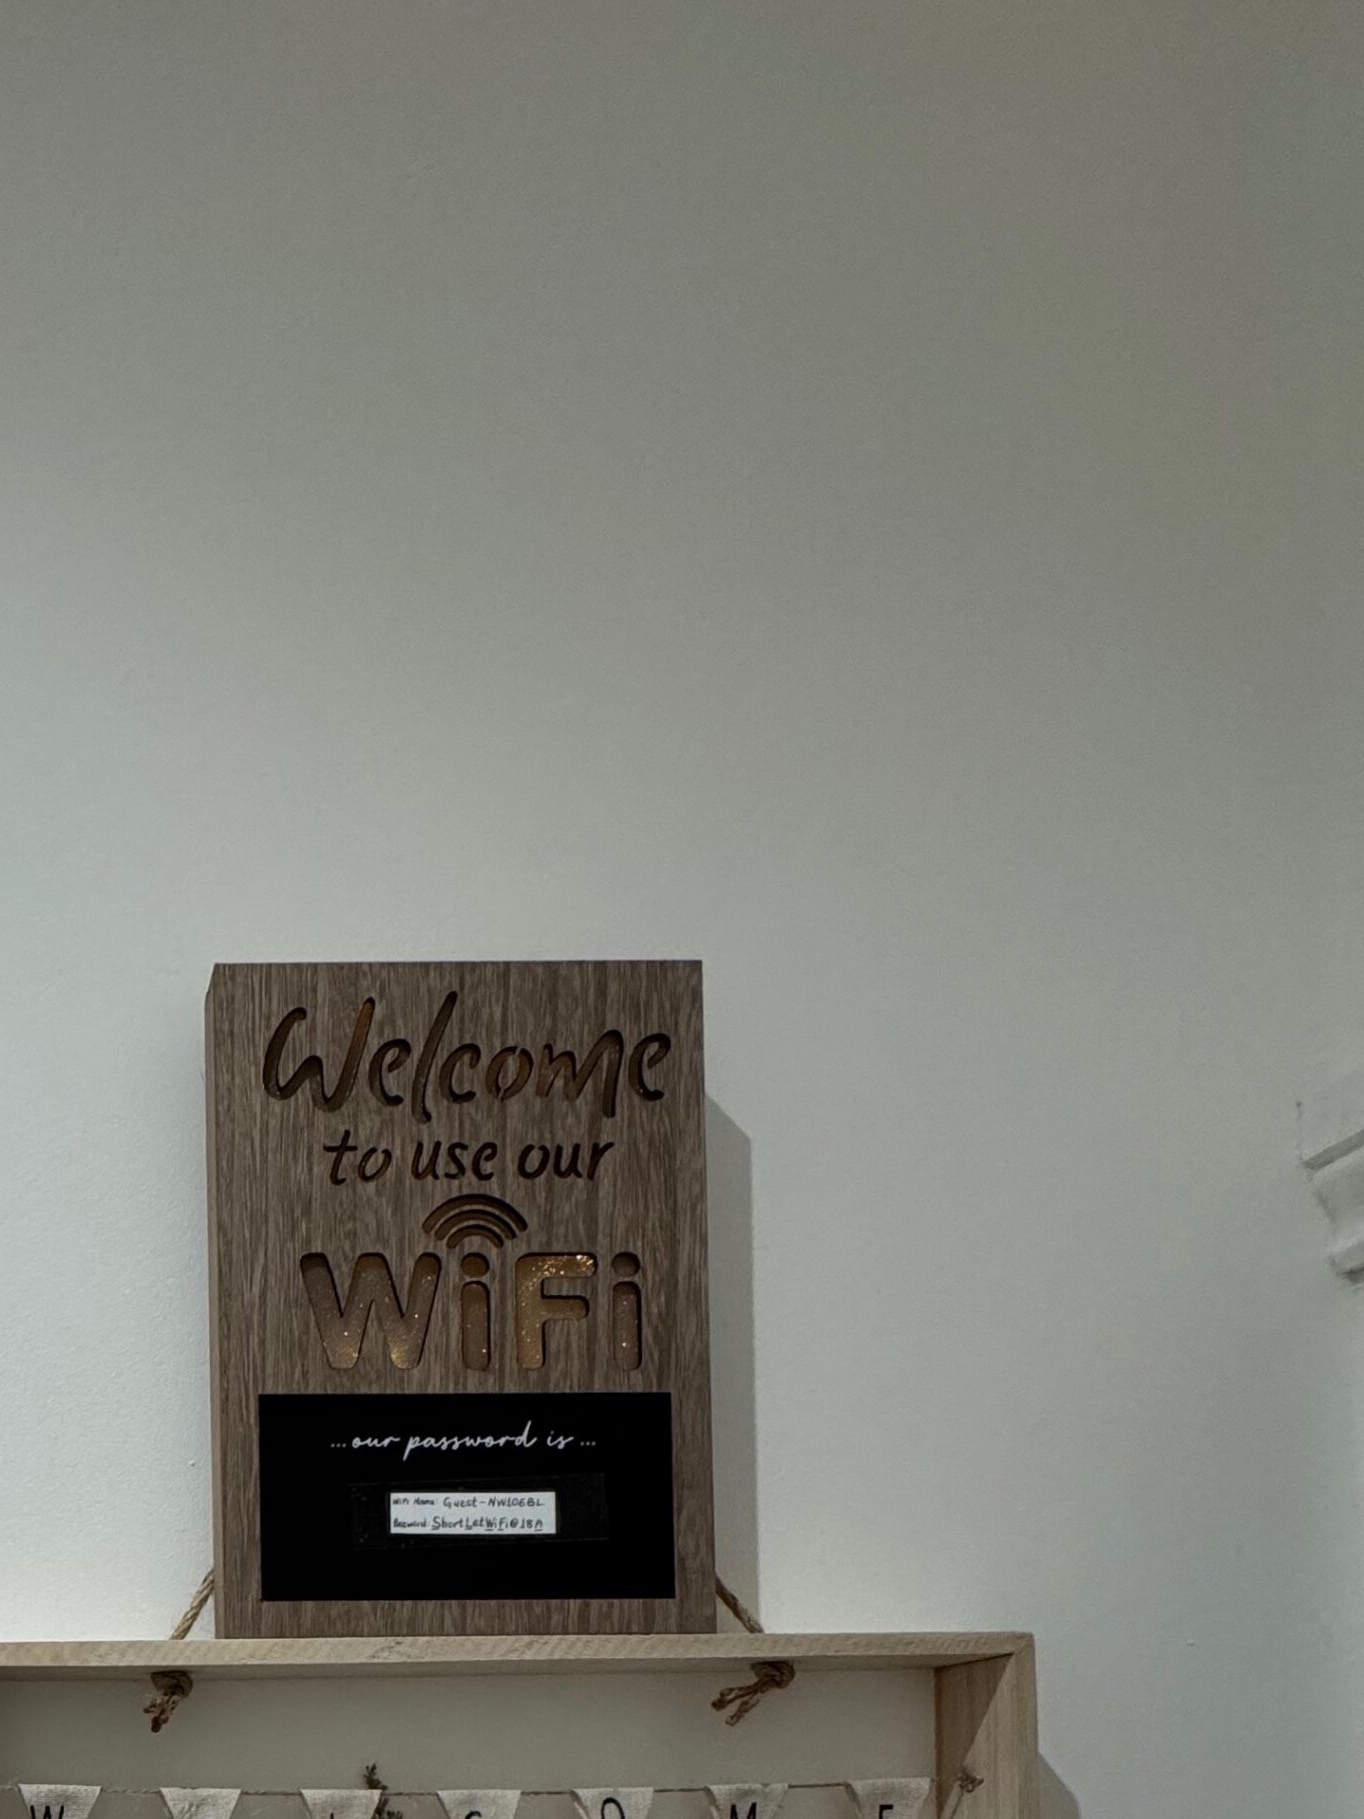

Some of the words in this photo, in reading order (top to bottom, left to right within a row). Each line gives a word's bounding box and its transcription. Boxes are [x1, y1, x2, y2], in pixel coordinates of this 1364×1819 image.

[263, 991, 671, 1123] Welcome
[323, 1129, 392, 1185] to
[411, 1141, 497, 1181] use
[517, 1141, 615, 1182] our
[300, 1252, 642, 1371] WiFi
[352, 1436, 400, 1449] our
[403, 1420, 537, 1461] password
[547, 1430, 574, 1449] is
